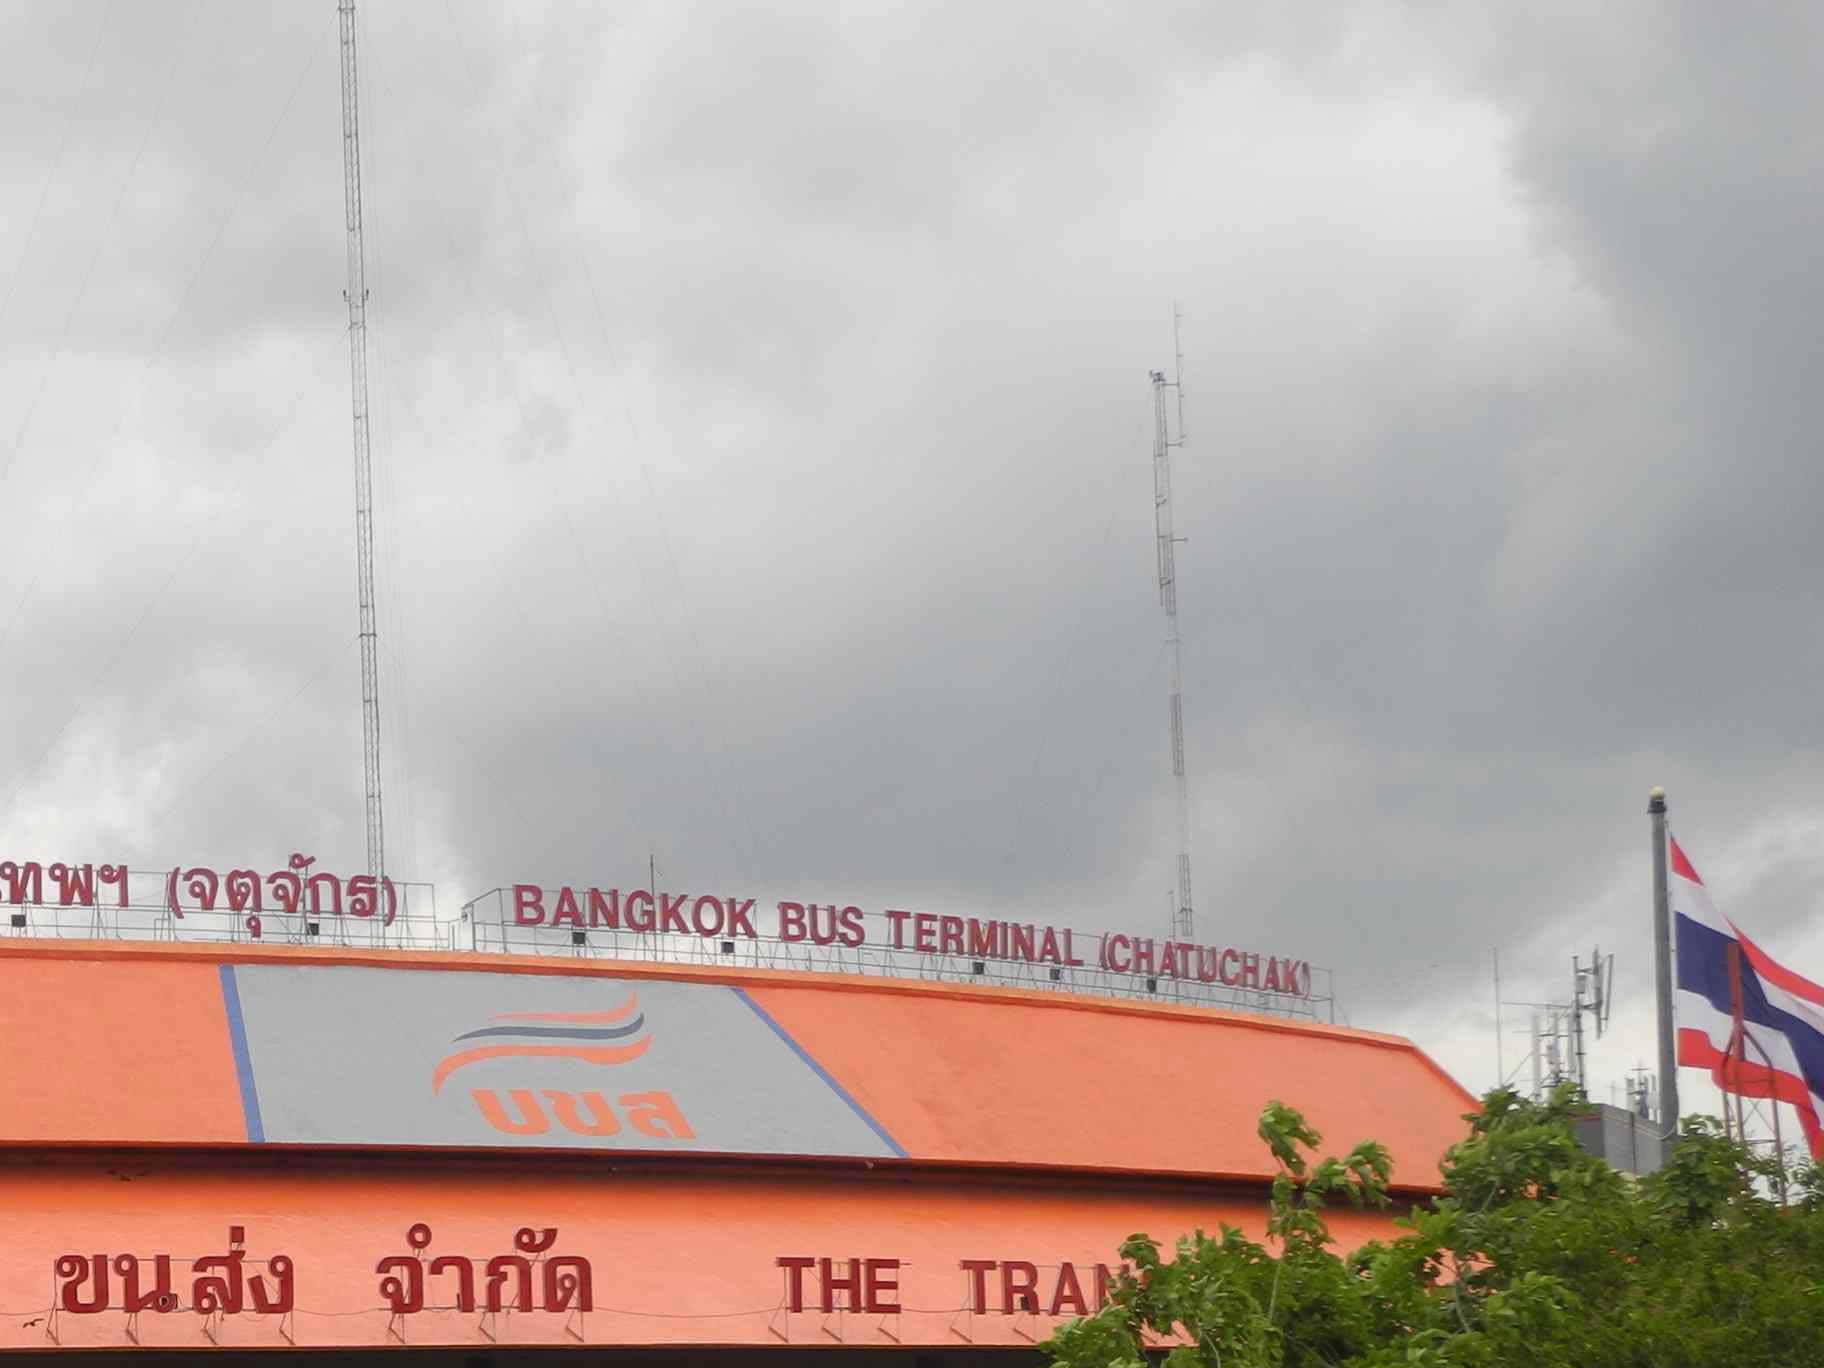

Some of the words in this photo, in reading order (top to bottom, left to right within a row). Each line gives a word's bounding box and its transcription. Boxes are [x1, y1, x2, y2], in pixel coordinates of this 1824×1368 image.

[168, 853, 397, 937] (จตุจักร)
[512, 884, 757, 938] BANGKOK
[778, 902, 864, 947] BUS
[885, 910, 1084, 967] TERMINAL
[1099, 931, 1312, 999] (CHATUCHAK)
[57, 1226, 295, 1315] ขนส่ง
[376, 1222, 593, 1314] จำกัด
[777, 1256, 902, 1315] THE
